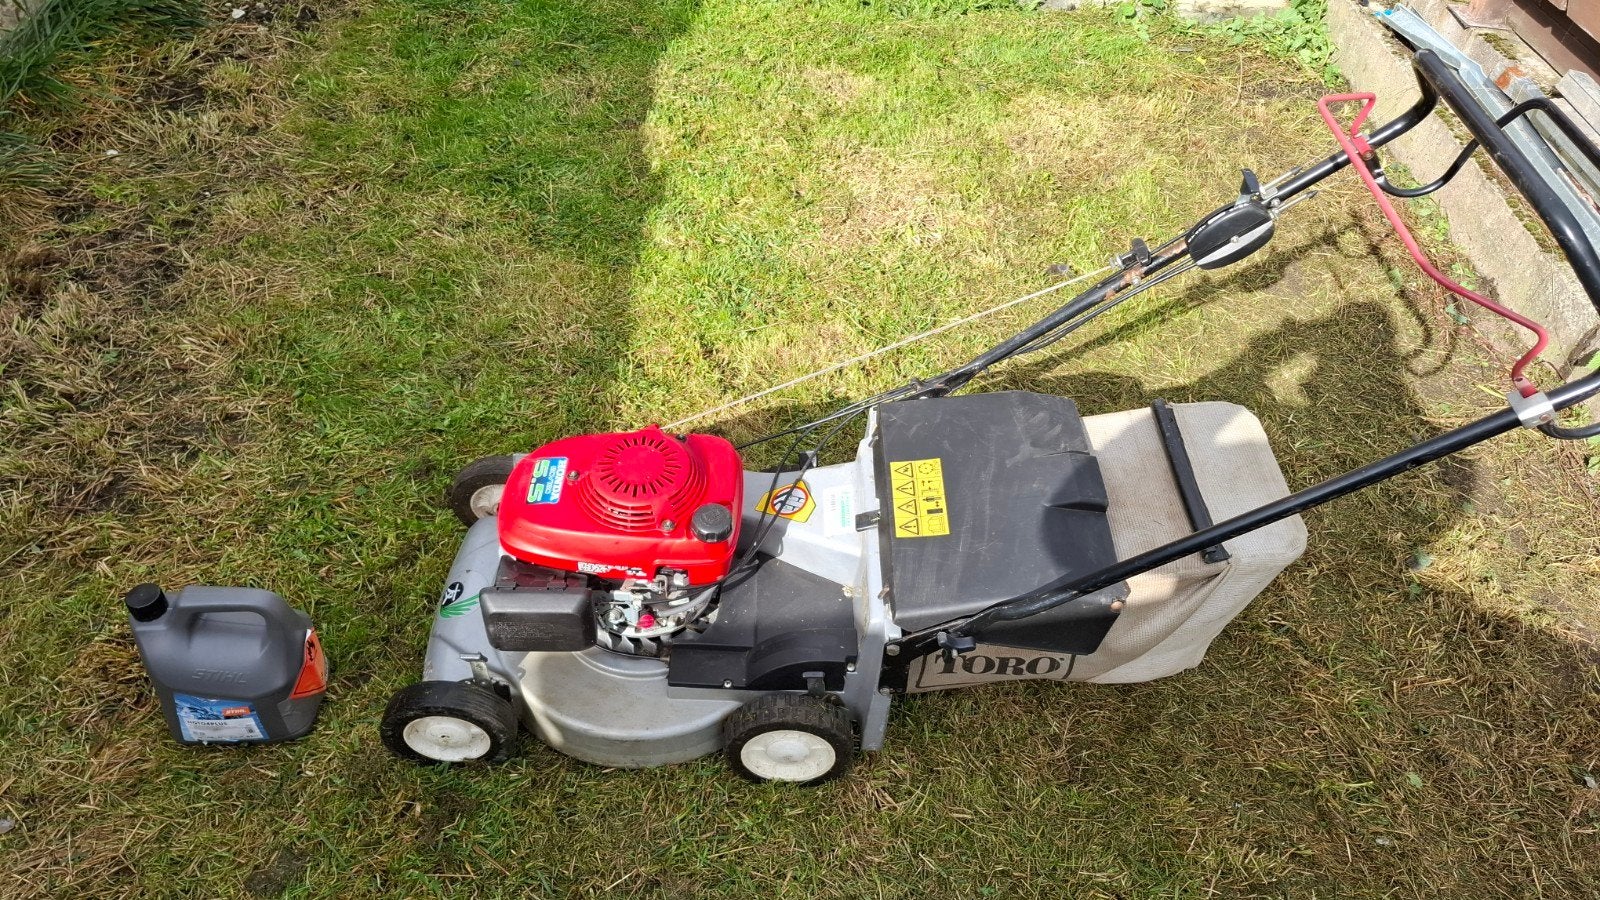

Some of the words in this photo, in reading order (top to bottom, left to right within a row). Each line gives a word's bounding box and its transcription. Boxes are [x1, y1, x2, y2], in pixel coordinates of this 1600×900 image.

[550, 459, 567, 501] HONDA
[934, 654, 1062, 675] TORO
[191, 668, 247, 684] STIHL
